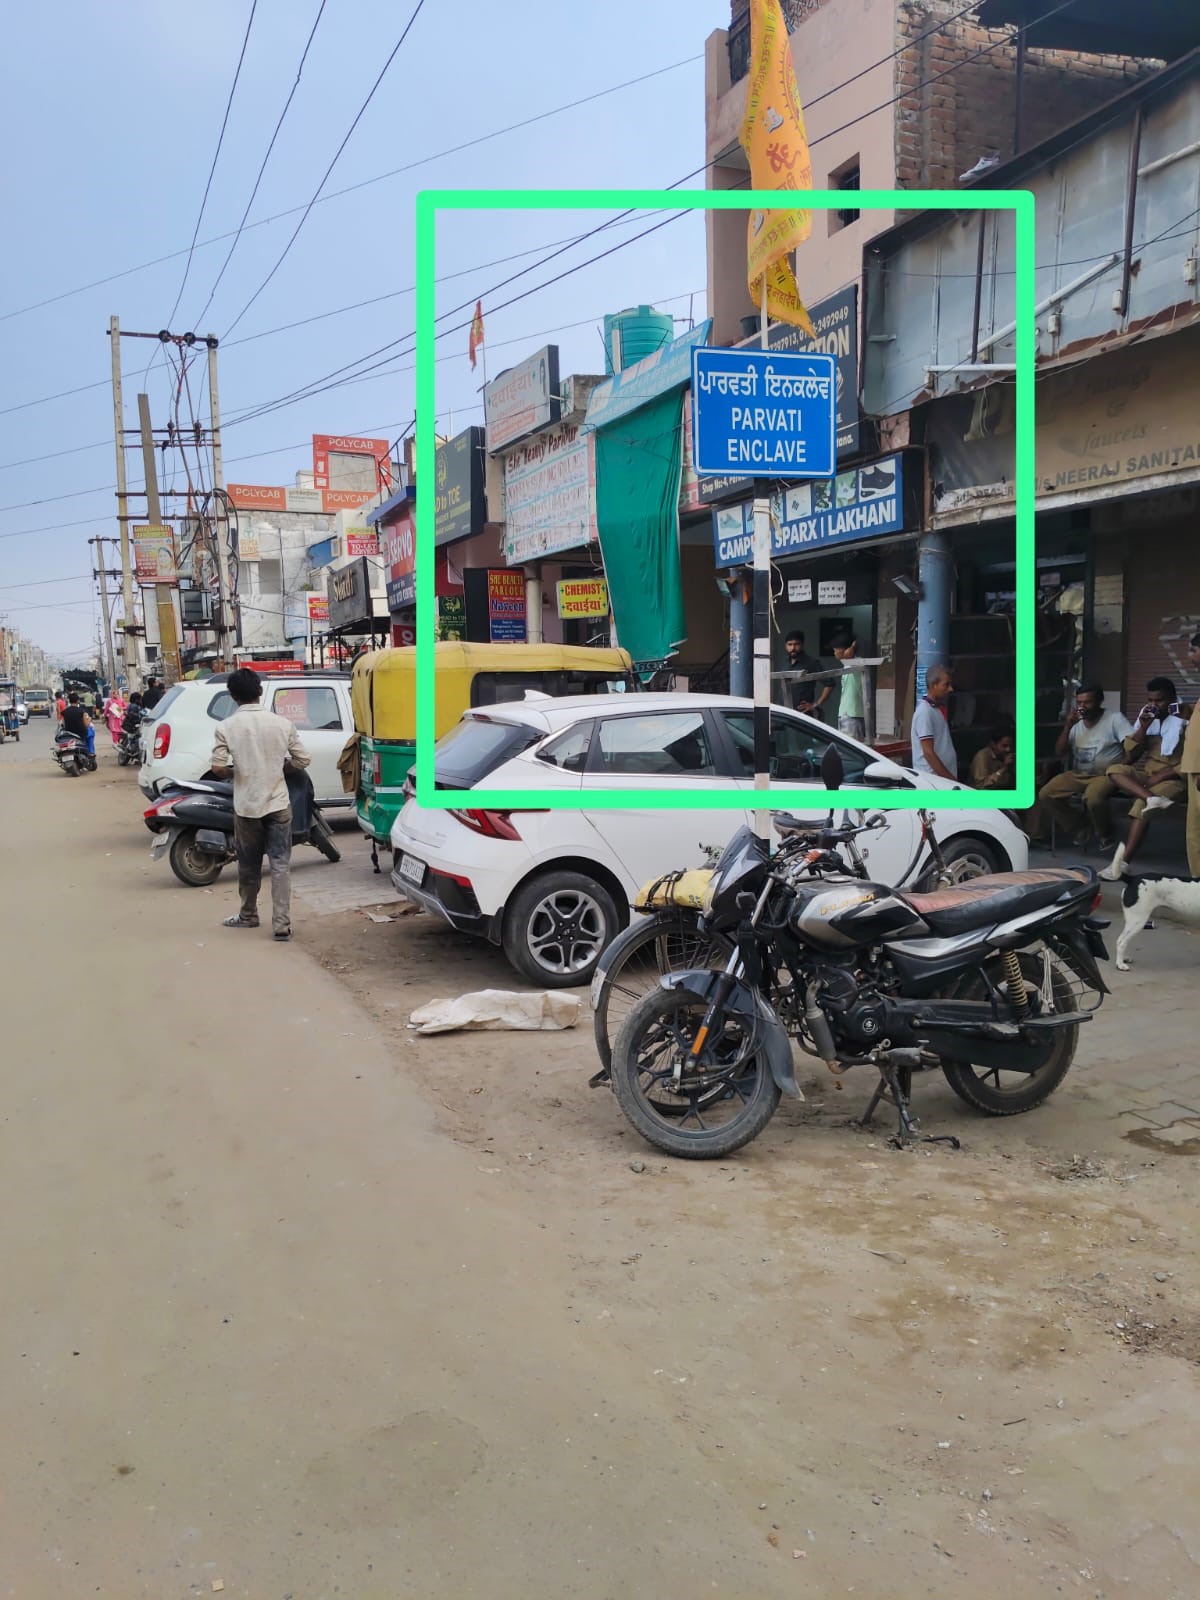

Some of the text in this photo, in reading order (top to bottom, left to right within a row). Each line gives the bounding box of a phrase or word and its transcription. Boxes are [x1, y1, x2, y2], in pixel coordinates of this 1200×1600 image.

[699, 364, 830, 399] ਪਾਰਵਤੀ ਇਨਕਲੇਵ
[731, 407, 802, 431] PARVATI
[328, 438, 374, 449] POLYCAB
[727, 439, 807, 462] ENCLAVE
[1056, 462, 1120, 487] NEERAJ
[235, 487, 281, 499] POLYCAB
[327, 492, 369, 503] POLYCAB
[775, 515, 817, 549] SPARX
[828, 499, 896, 536] LAKHANI
[565, 583, 601, 596] CHEMIST
[286, 704, 304, 714] TOE
